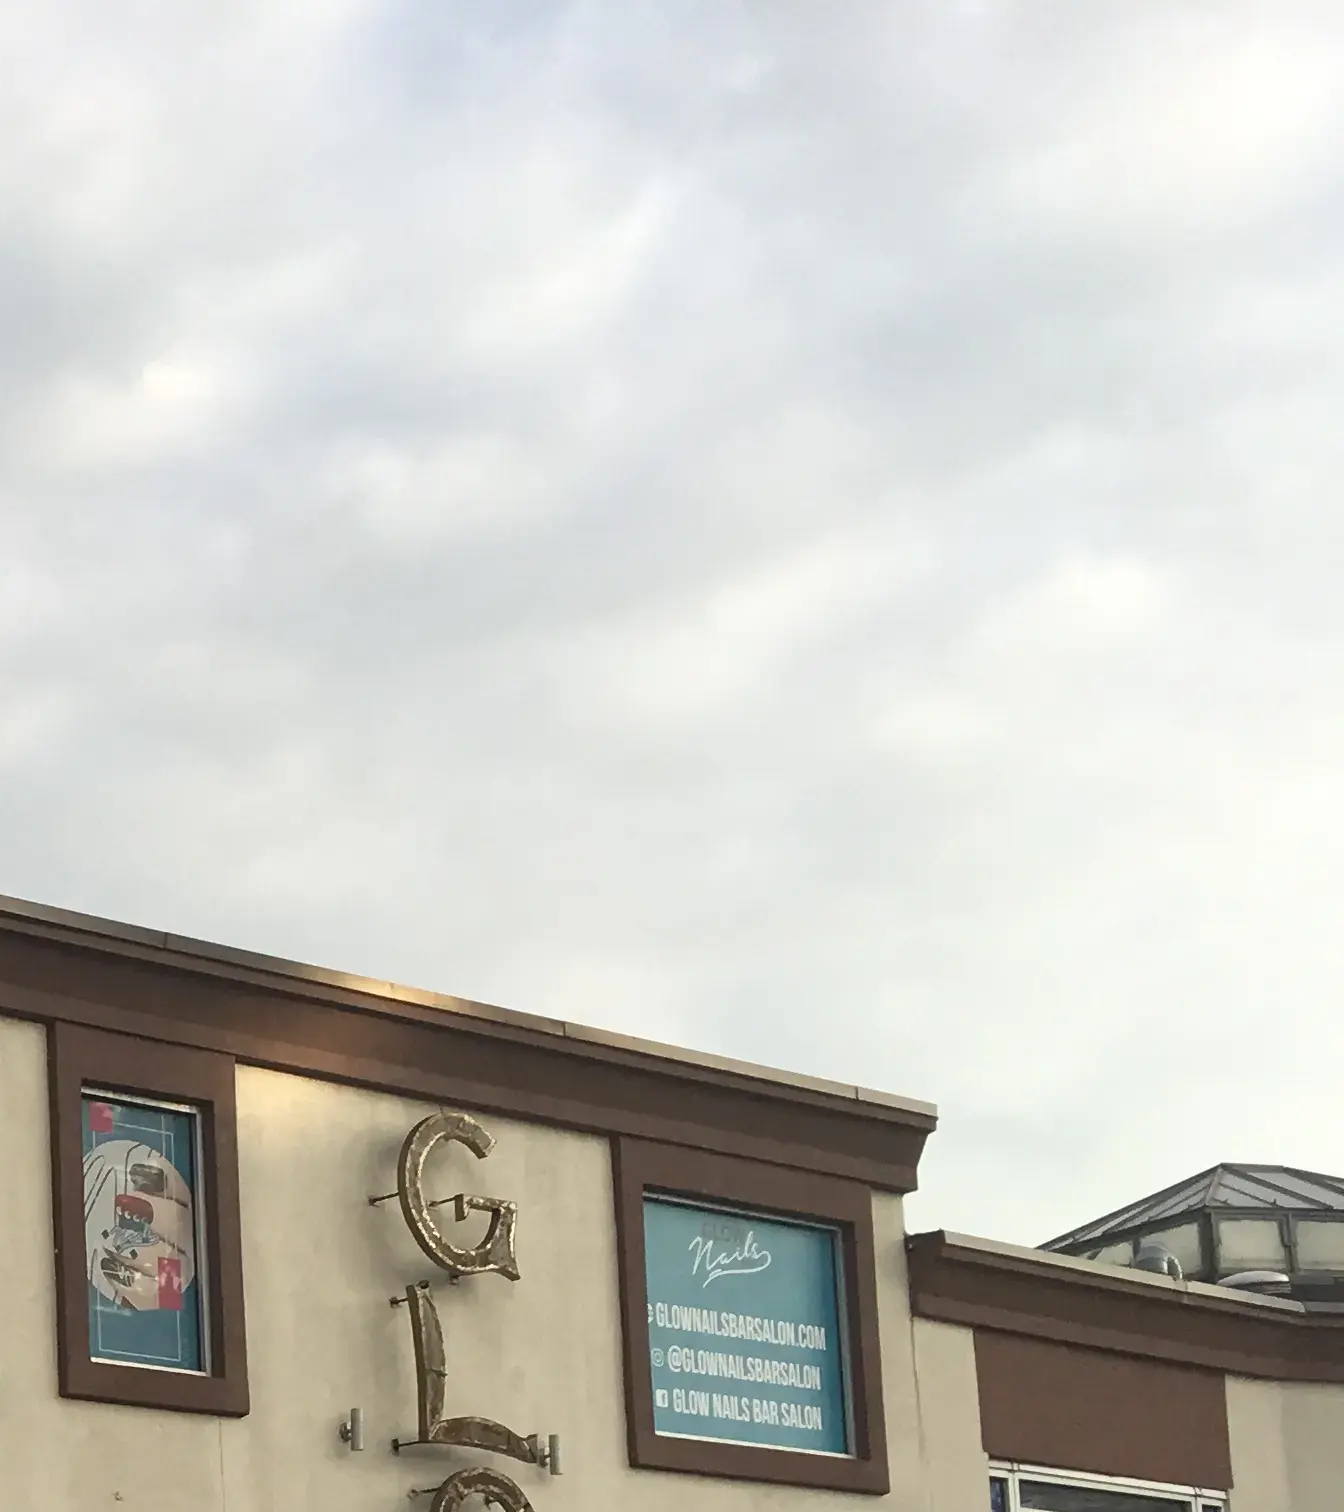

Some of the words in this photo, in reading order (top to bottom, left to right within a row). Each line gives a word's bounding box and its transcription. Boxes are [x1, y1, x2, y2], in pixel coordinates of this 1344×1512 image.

[689, 1231, 771, 1288] Nails
[656, 1302, 827, 1350] GLOWNAILSBARSALON.COM
[668, 1345, 821, 1390] @GLOWNAILSBARSALON
[672, 1388, 710, 1417] GLOW
[713, 1393, 750, 1422] NAILS
[753, 1398, 779, 1426] BAR
[781, 1402, 823, 1430] SALON
